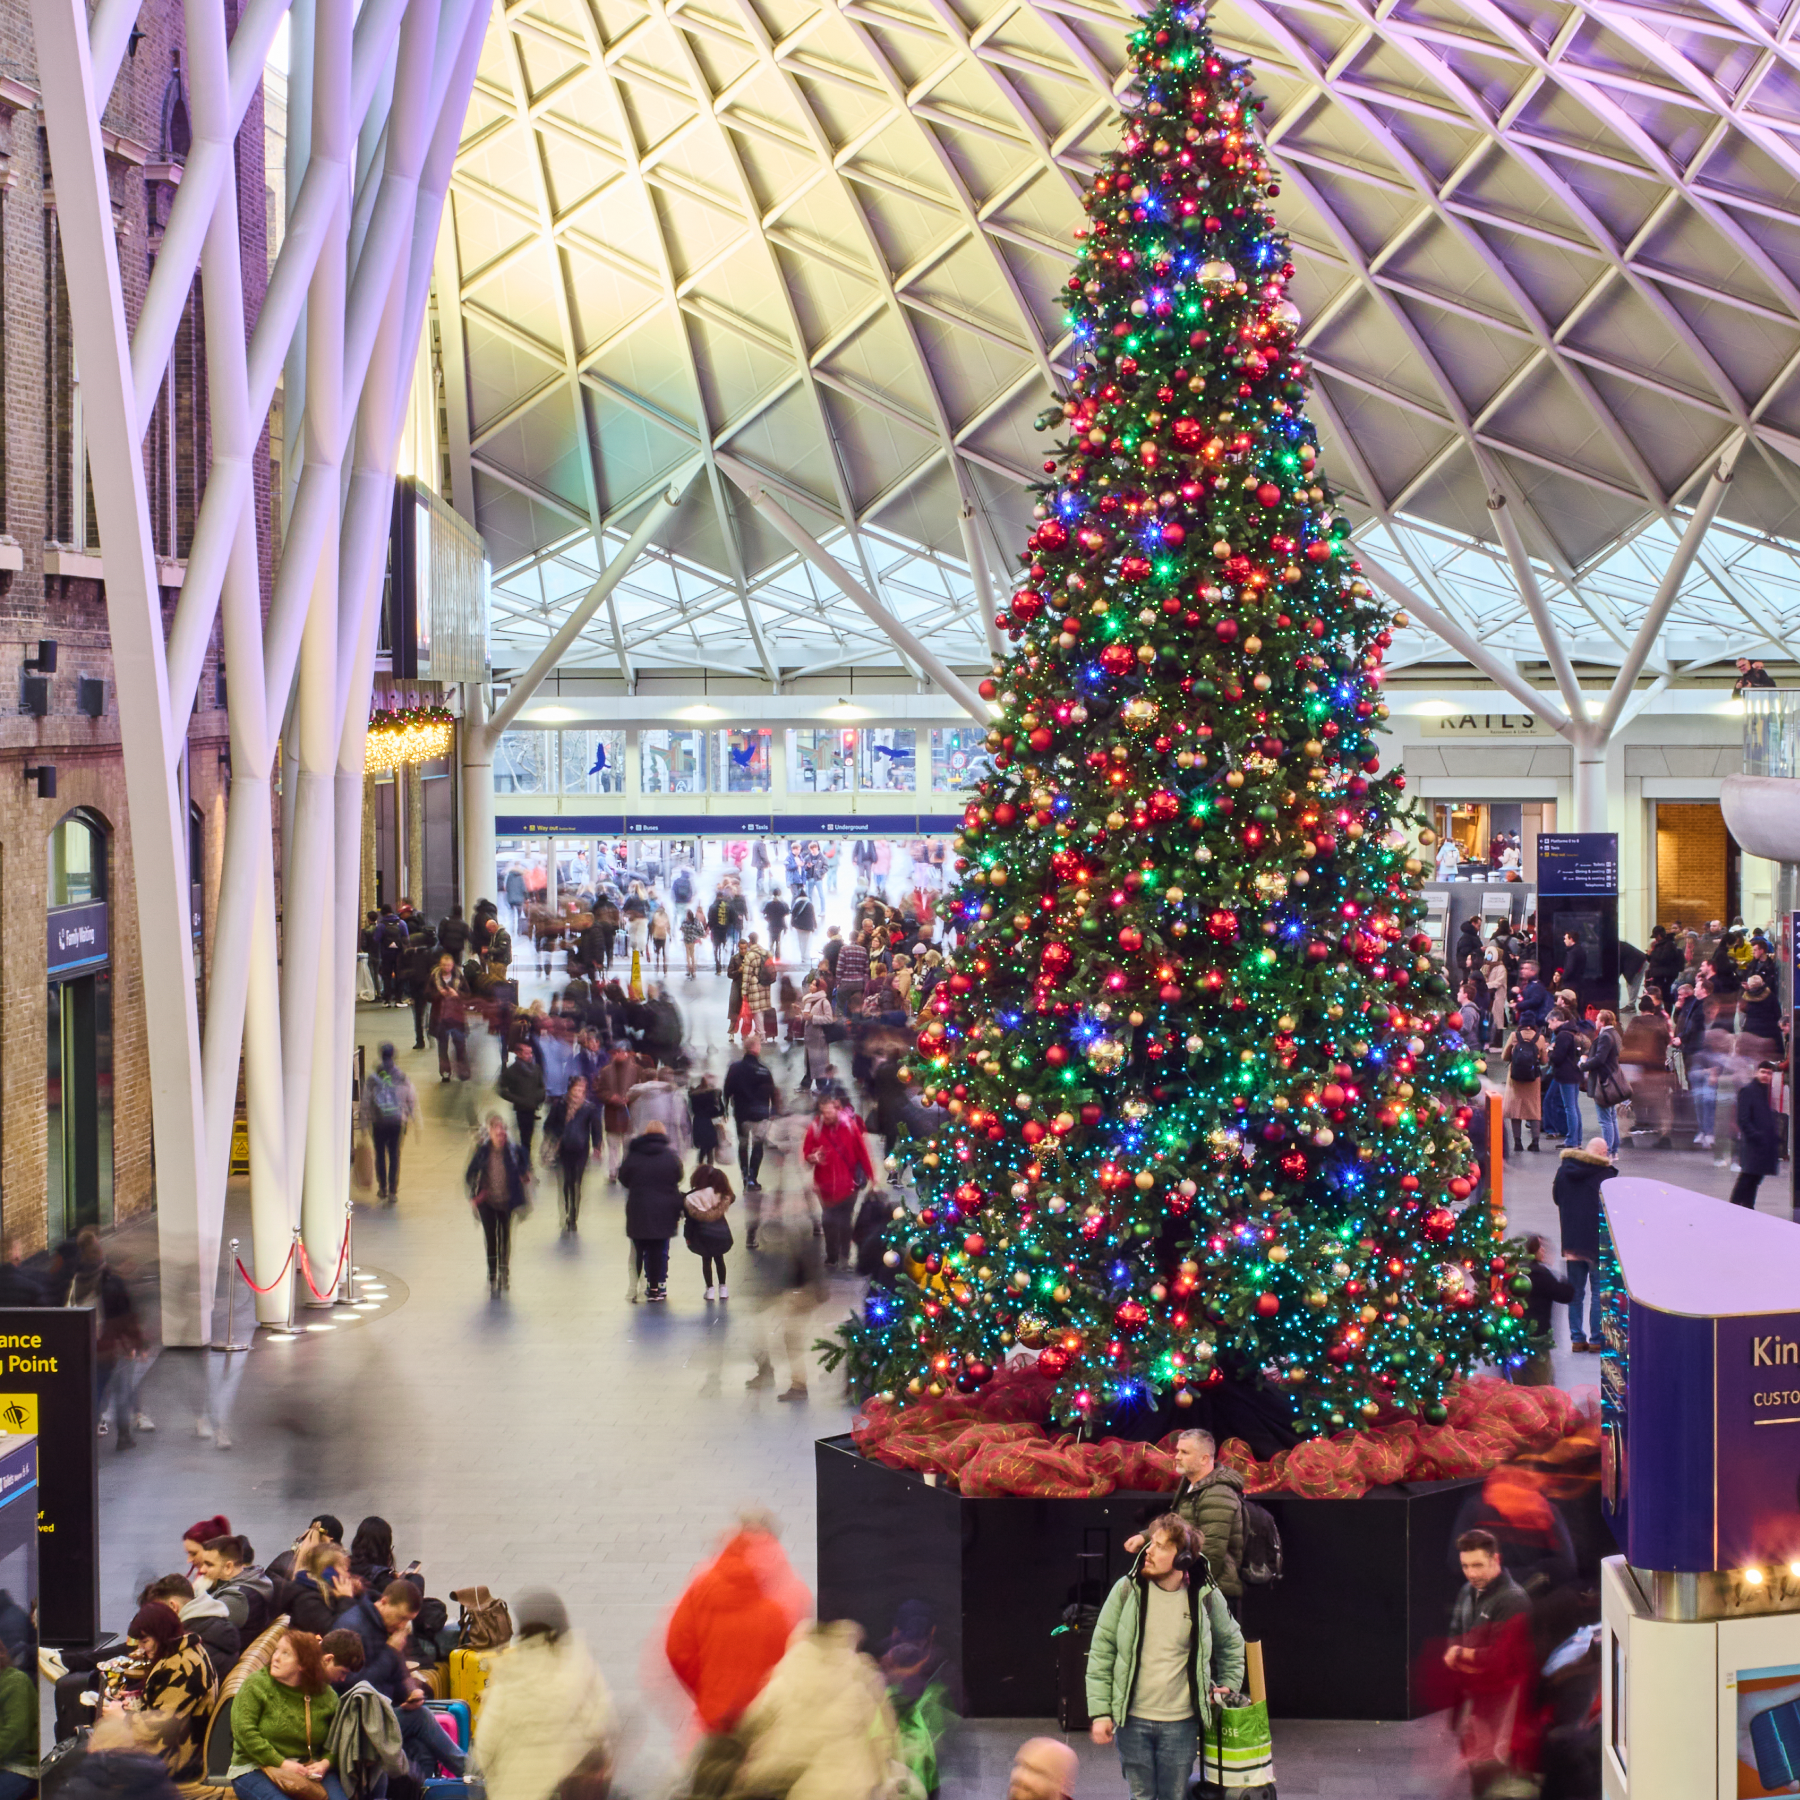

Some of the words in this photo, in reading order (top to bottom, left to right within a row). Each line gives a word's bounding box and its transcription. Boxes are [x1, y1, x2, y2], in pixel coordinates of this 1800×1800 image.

[0, 1335, 42, 1348] ance
[1754, 1336, 1798, 1366] Kin
[9, 1355, 58, 1372] Point
[1754, 1390, 1800, 1406] CUSTO
